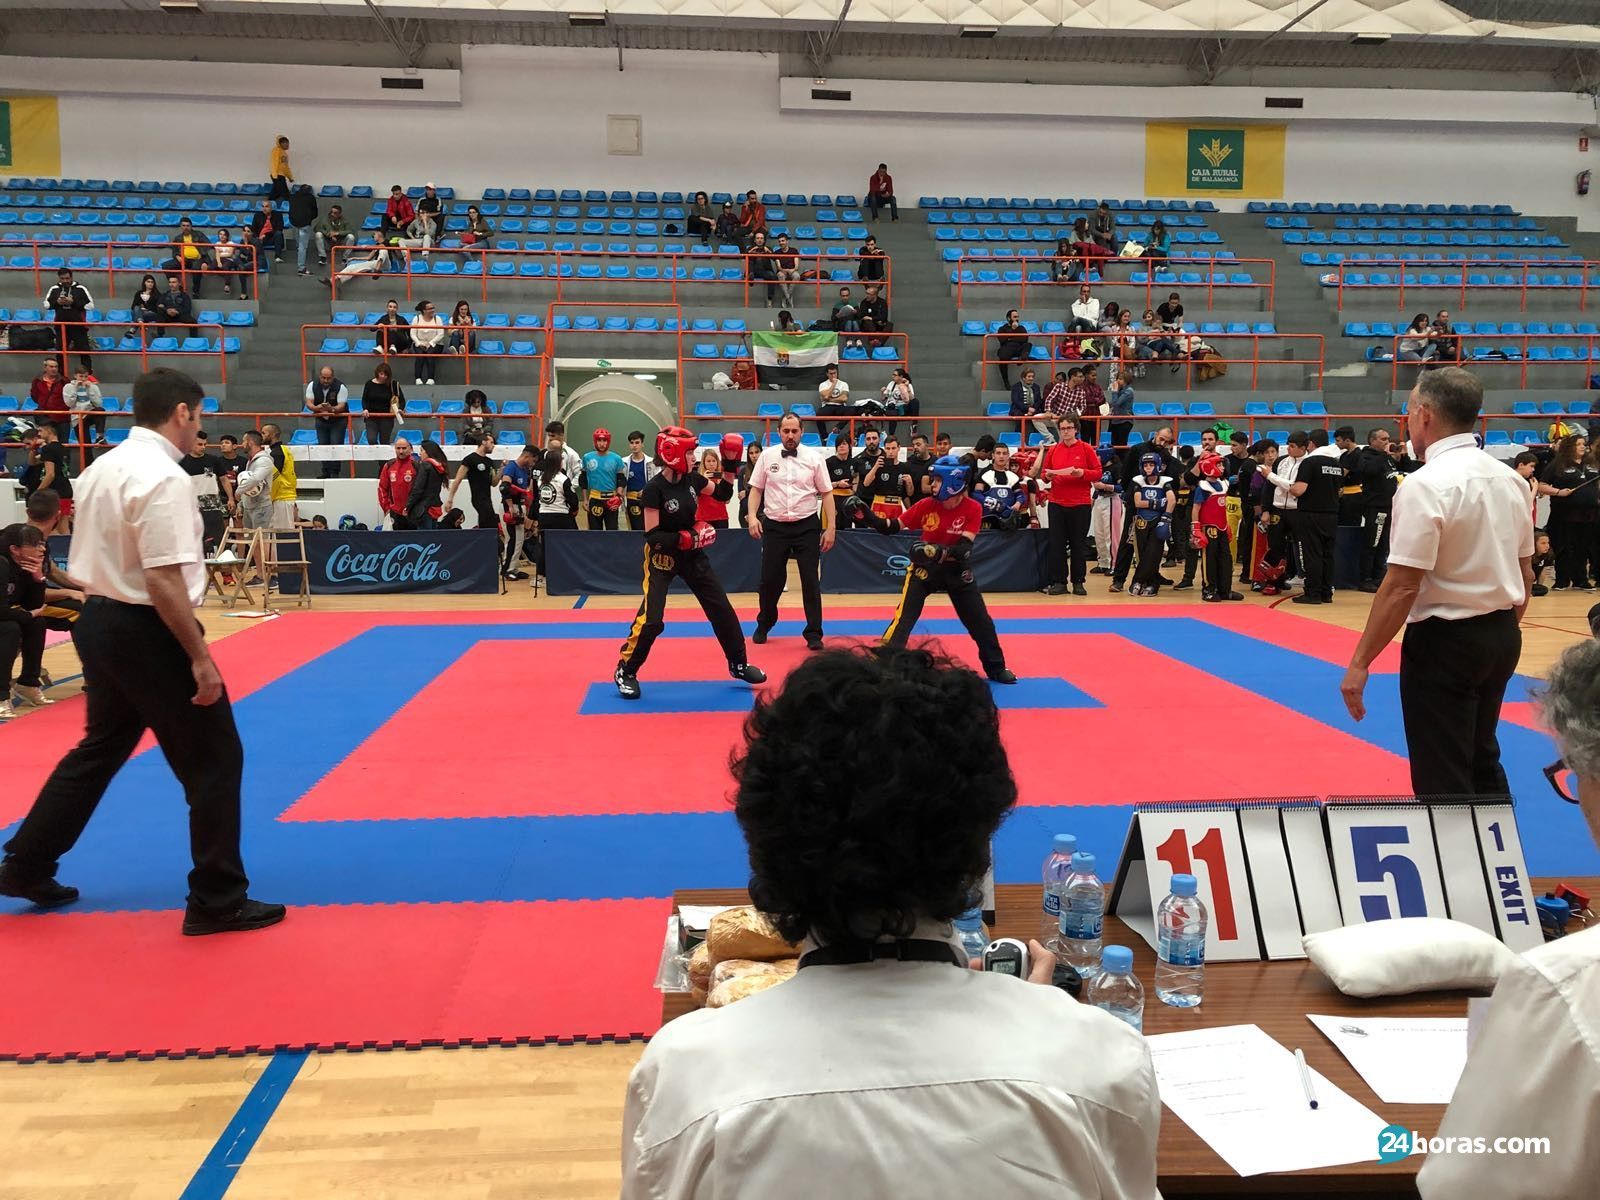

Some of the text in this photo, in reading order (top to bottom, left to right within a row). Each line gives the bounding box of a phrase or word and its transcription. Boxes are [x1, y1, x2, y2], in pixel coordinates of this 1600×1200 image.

[1212, 169, 1238, 177] RURAL
[325, 543, 441, 583] Coca-Cola
[1350, 826, 1428, 919] 5
[1495, 866, 1530, 925] EXIT
